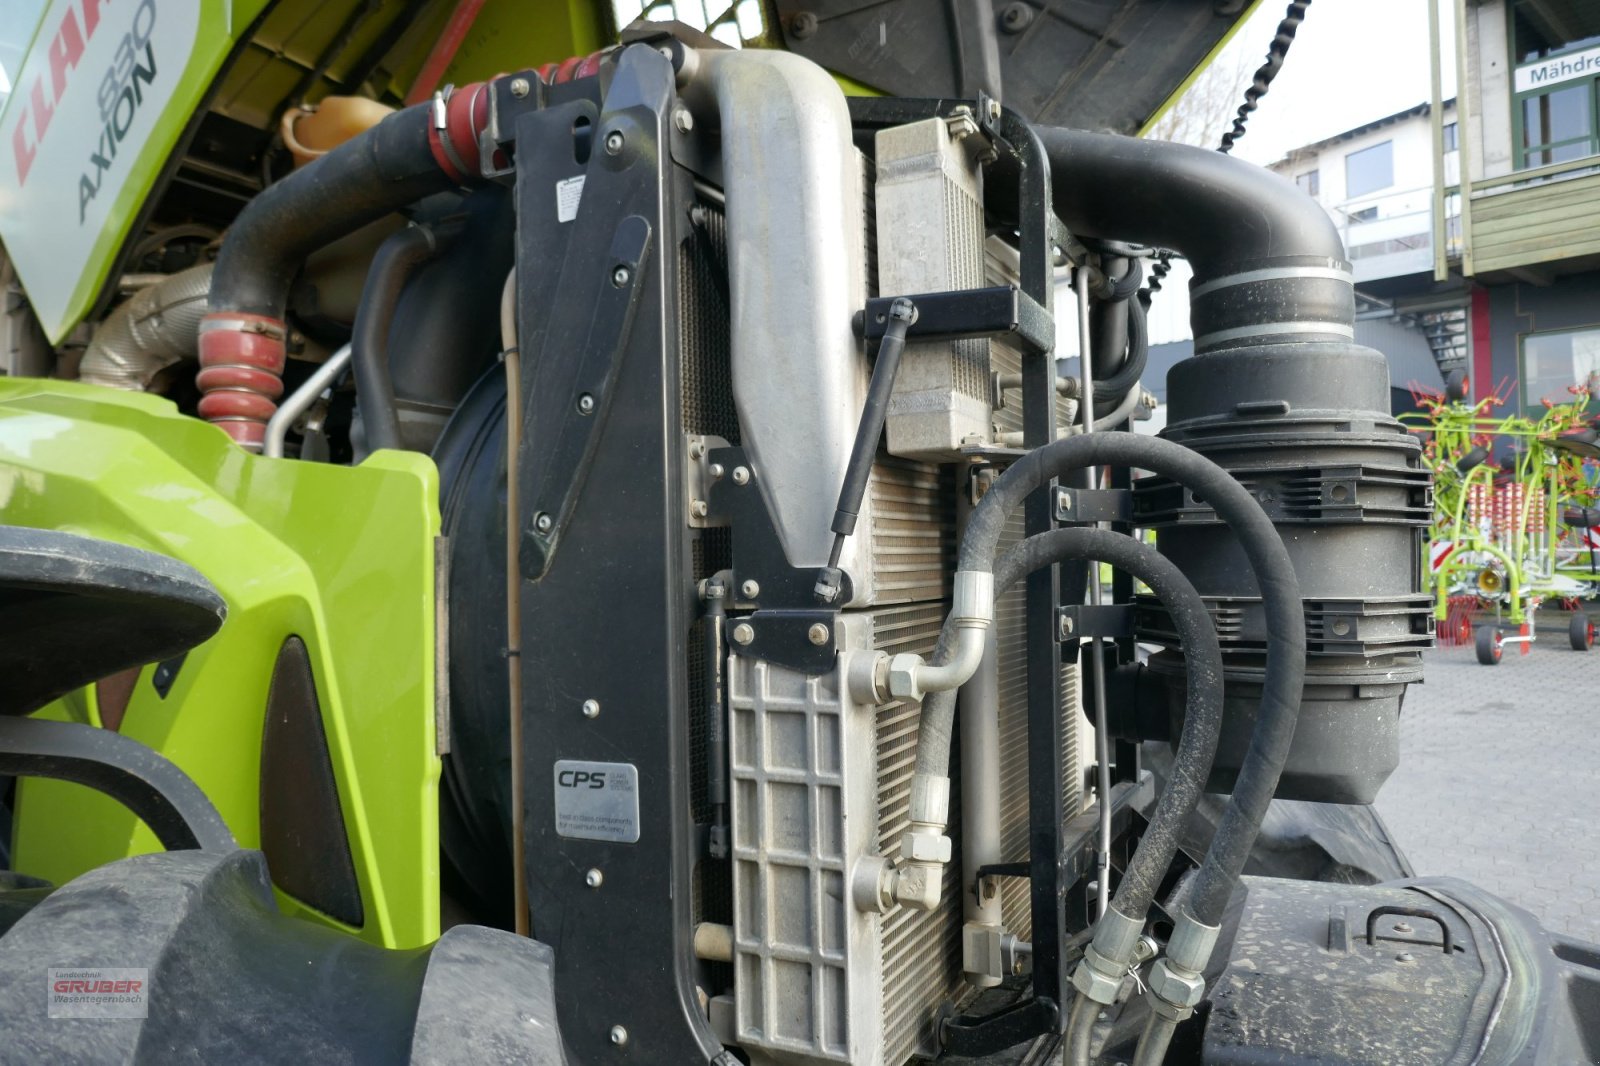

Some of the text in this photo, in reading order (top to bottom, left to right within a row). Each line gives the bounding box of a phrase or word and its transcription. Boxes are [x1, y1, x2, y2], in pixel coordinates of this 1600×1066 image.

[97, 0, 157, 123] 830
[77, 39, 157, 226] AXION
[558, 770, 606, 789] CPS
